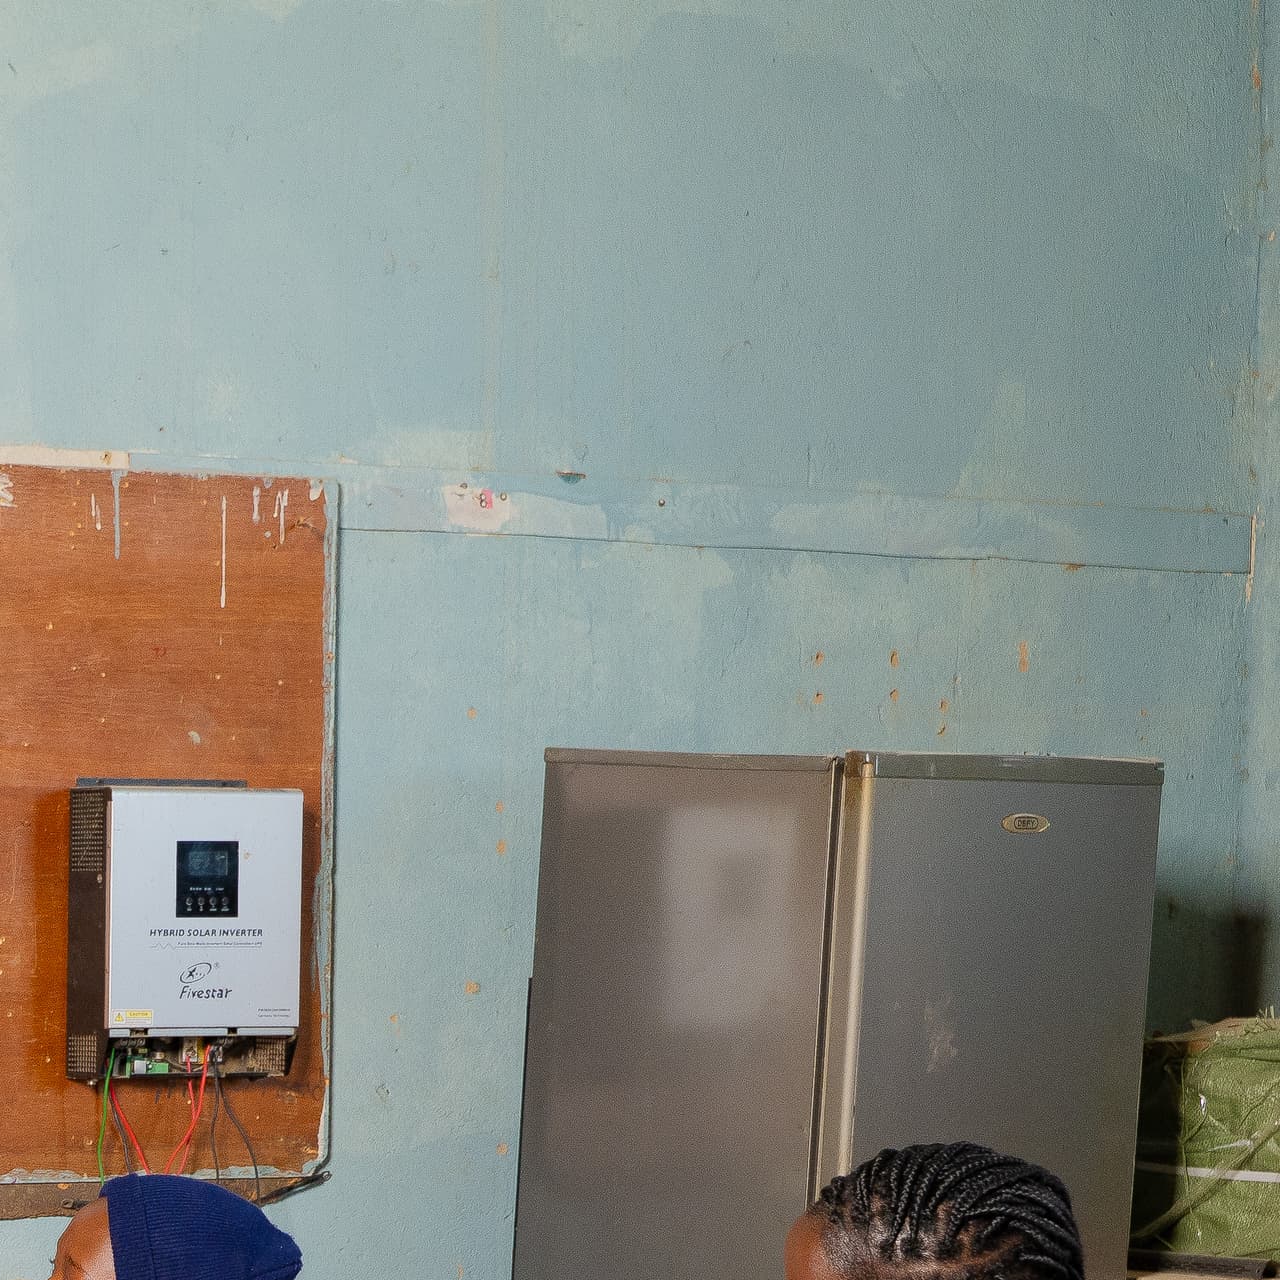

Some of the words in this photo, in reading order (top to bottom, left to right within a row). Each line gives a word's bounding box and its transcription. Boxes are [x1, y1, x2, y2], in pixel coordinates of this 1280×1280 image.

[149, 928, 185, 937] HYBRID
[187, 928, 217, 937] SOLAR
[219, 928, 263, 937] INVERTER
[179, 985, 233, 999] Fivestar
